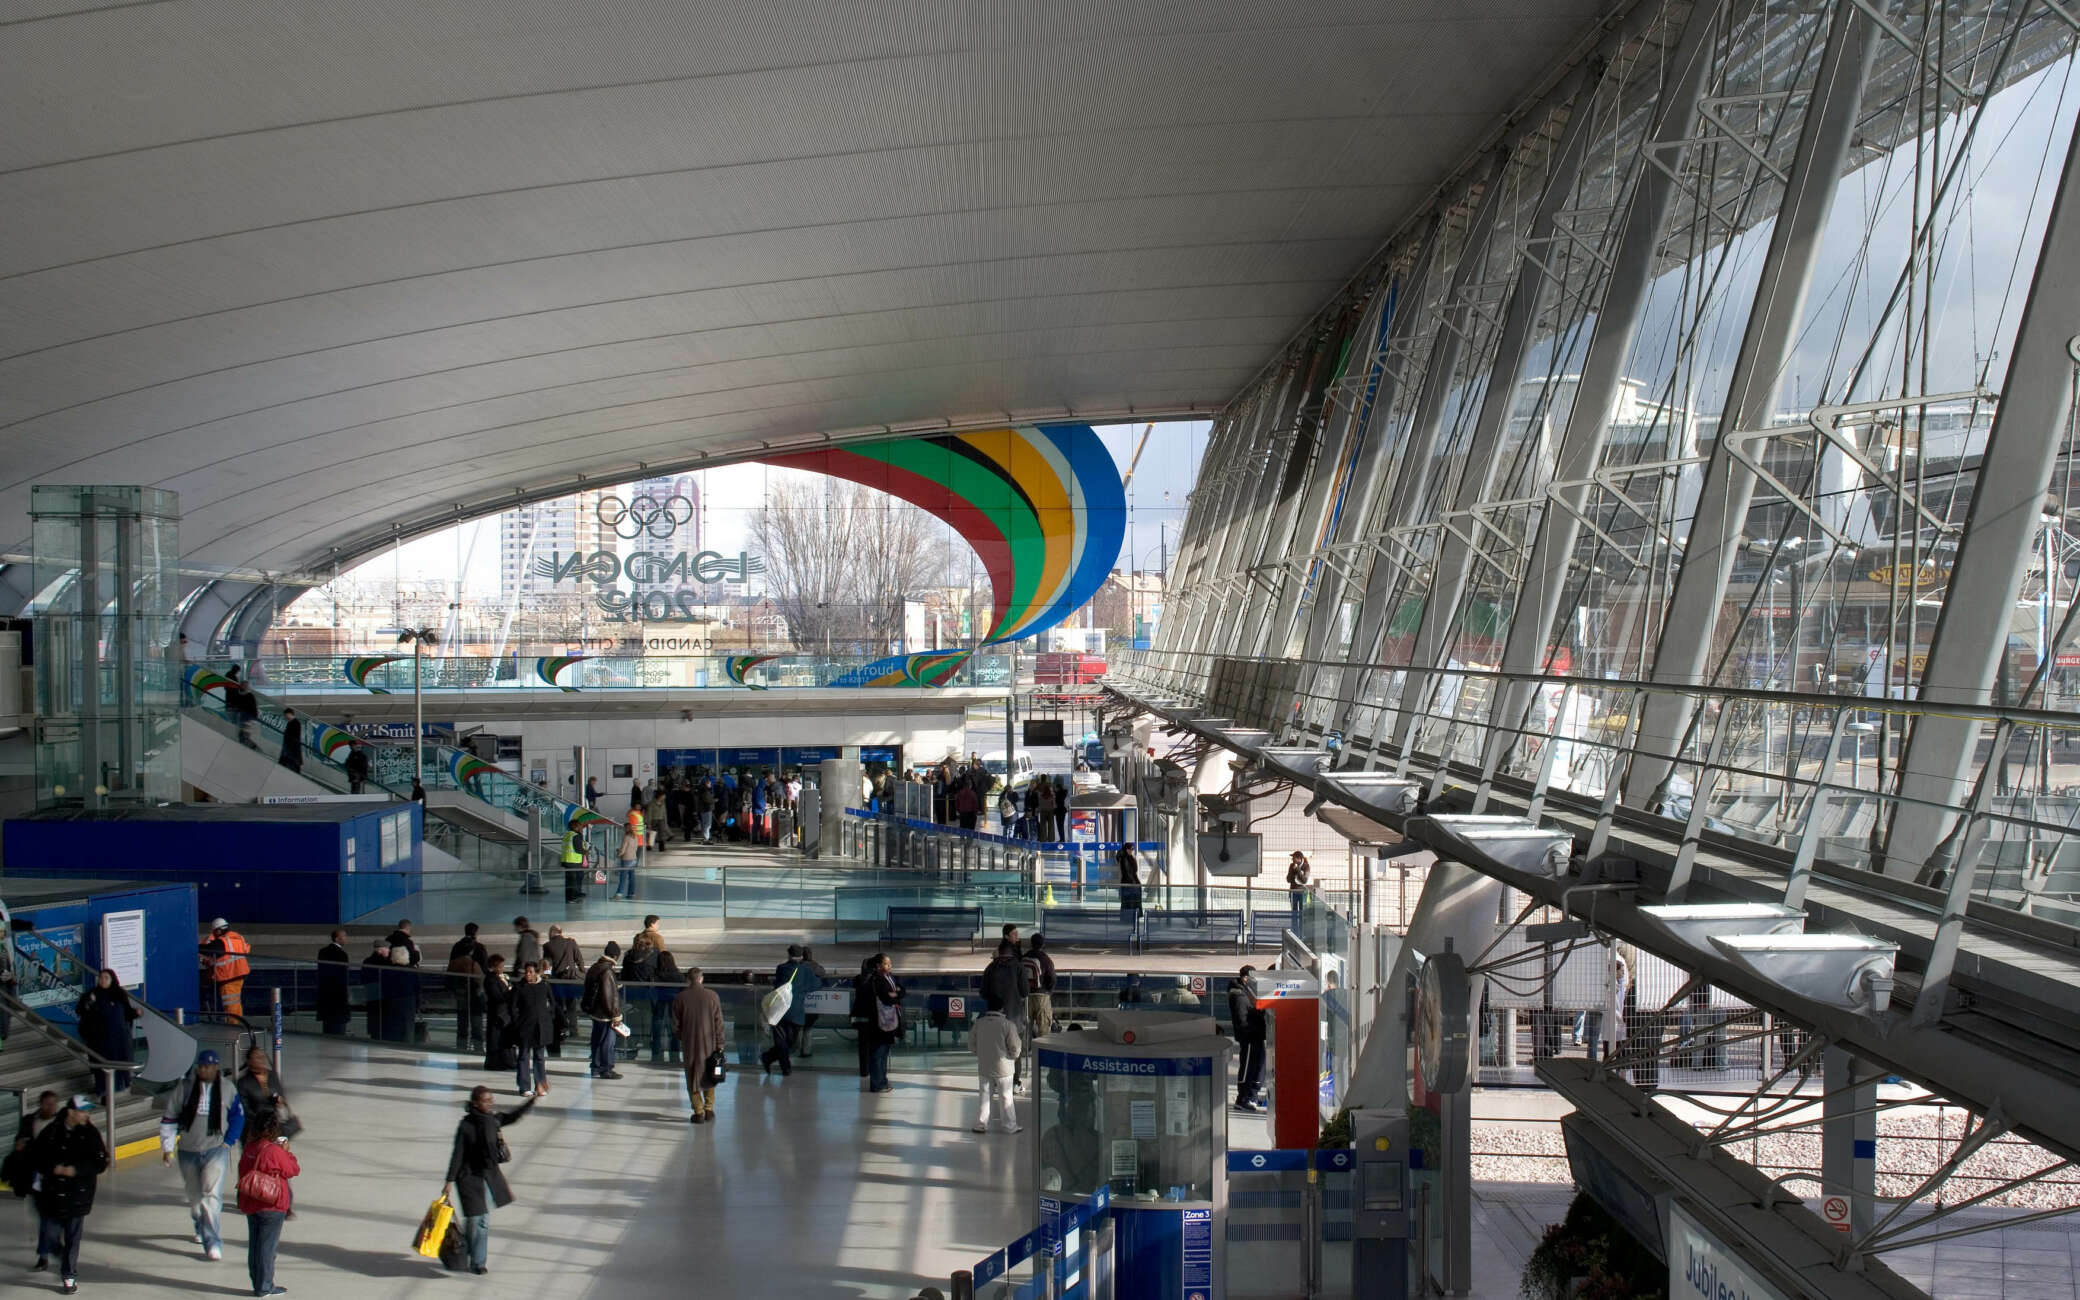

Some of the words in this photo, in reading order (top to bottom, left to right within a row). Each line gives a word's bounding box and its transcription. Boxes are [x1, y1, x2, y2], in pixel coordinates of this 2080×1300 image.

[857, 662, 894, 675] Proud
[1082, 1057, 1156, 1073] Assistance
[1205, 1210, 1210, 1218] 3
